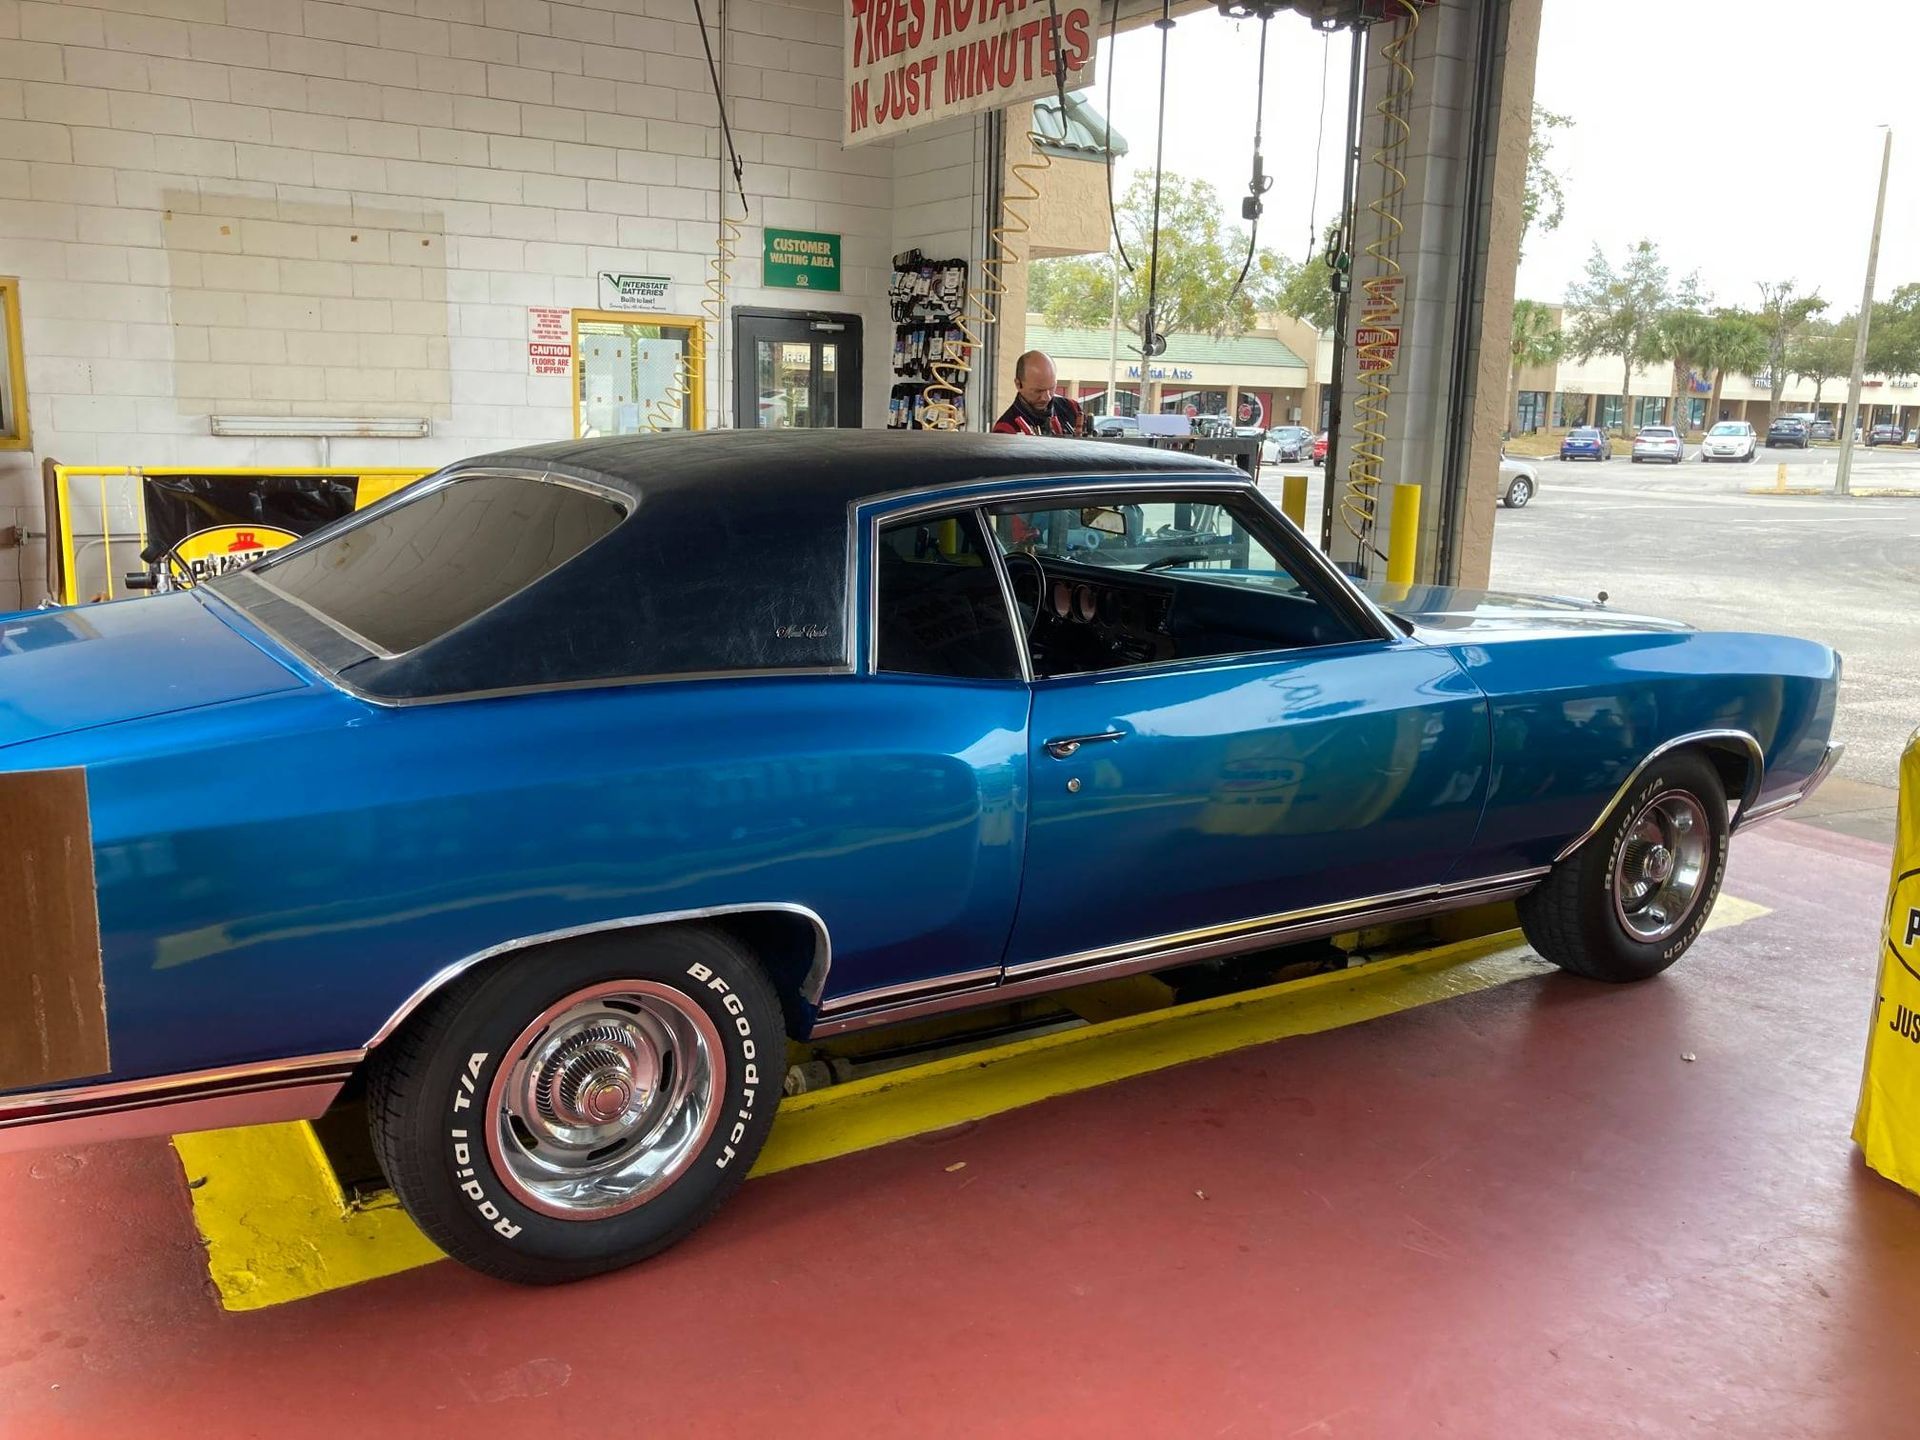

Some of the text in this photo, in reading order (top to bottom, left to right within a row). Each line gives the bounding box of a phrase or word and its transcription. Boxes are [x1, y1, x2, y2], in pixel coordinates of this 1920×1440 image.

[851, 79, 868, 133] IN
[875, 55, 938, 124] JUST
[944, 8, 1090, 105] MINUTES
[773, 237, 831, 255] CUSTOMER
[769, 251, 835, 268] WAITING AREA
[621, 288, 664, 297] BATTERIES
[622, 280, 669, 290] INTERSTATE
[531, 345, 570, 356] CAUTION
[531, 357, 570, 366] FLOORS ARE
[535, 366, 566, 374] SLIPPERY
[1171, 367, 1193, 380] Arts
[1604, 776, 1664, 890] Radial T/A
[687, 961, 760, 1170] BFGoodrich
[451, 1051, 522, 1240] Radial T/A
